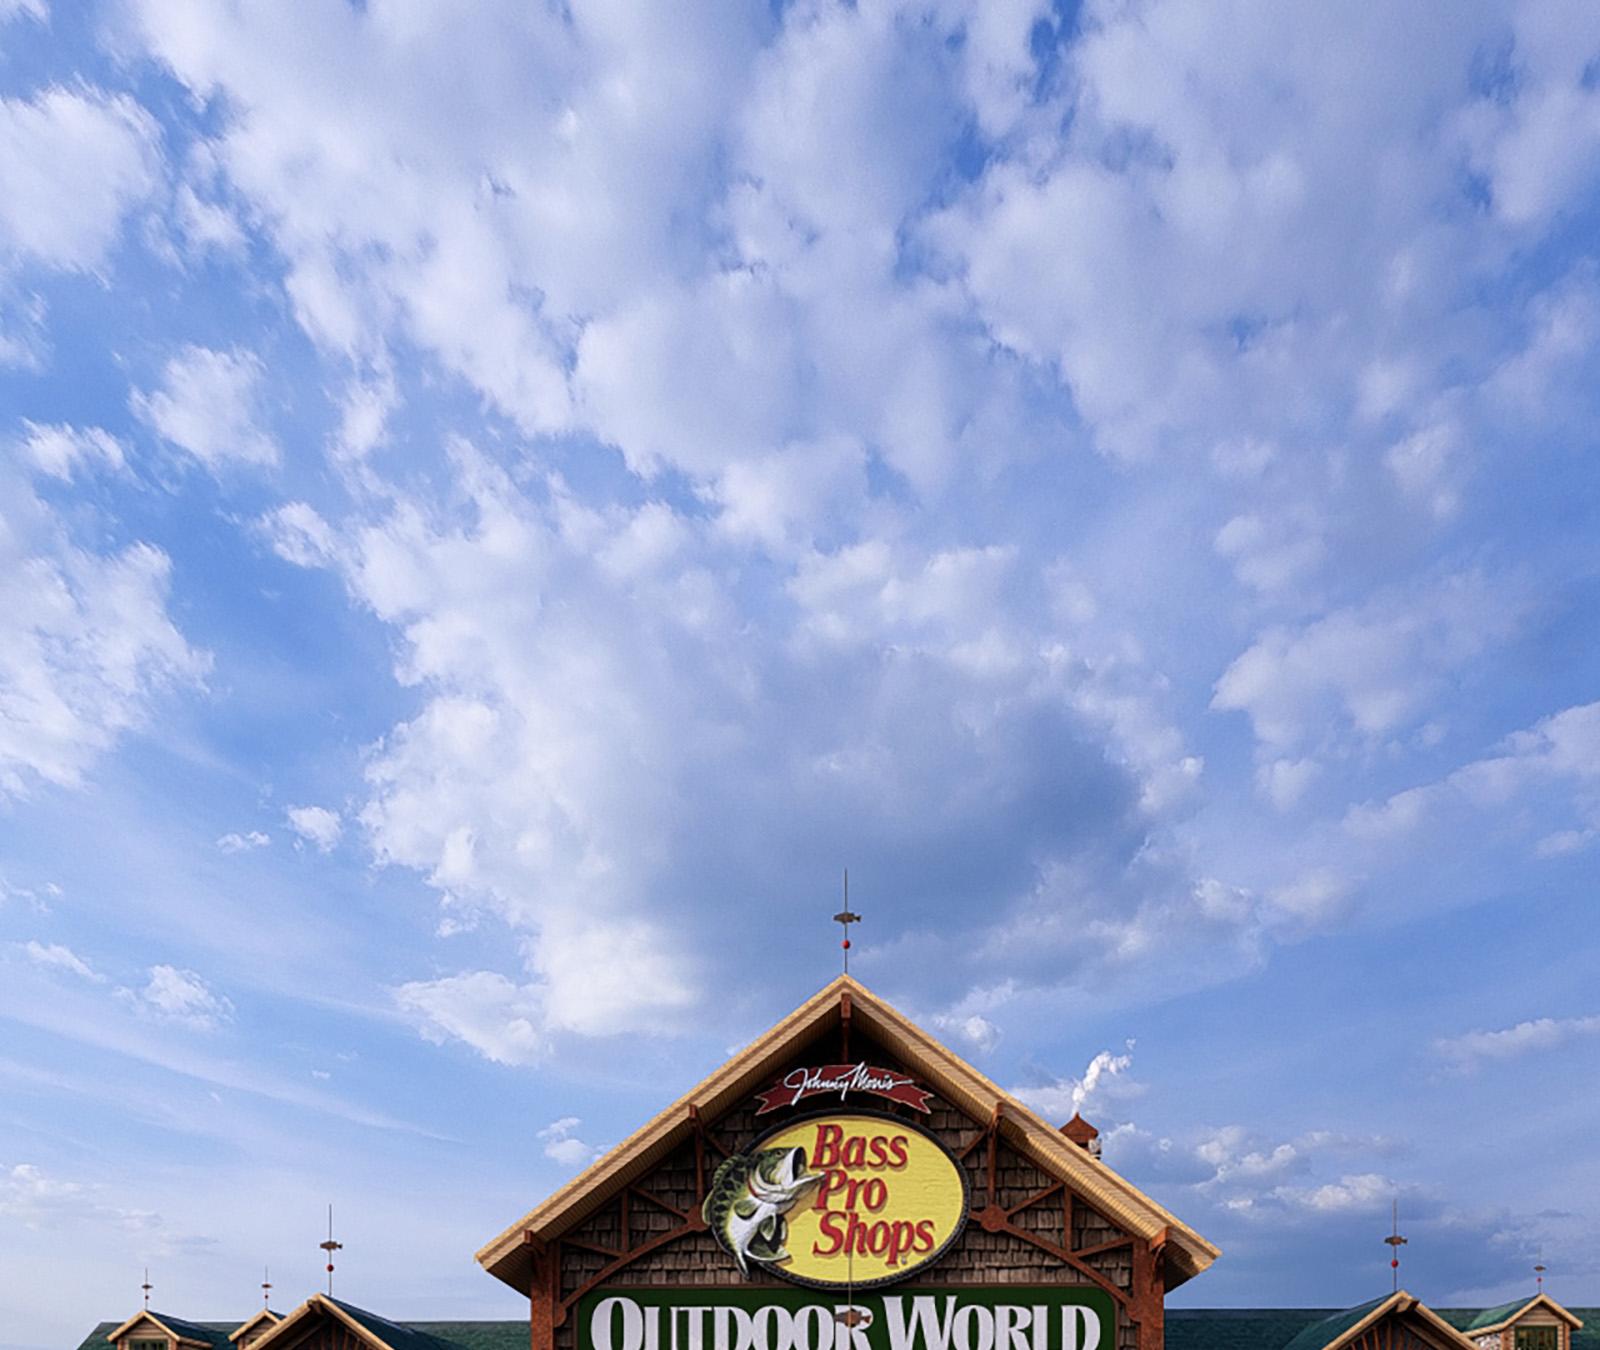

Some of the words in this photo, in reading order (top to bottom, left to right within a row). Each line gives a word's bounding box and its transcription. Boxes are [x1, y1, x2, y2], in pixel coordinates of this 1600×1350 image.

[809, 1124, 909, 1168] Bass
[811, 1169, 888, 1211] Pro
[812, 1210, 936, 1265] Shops
